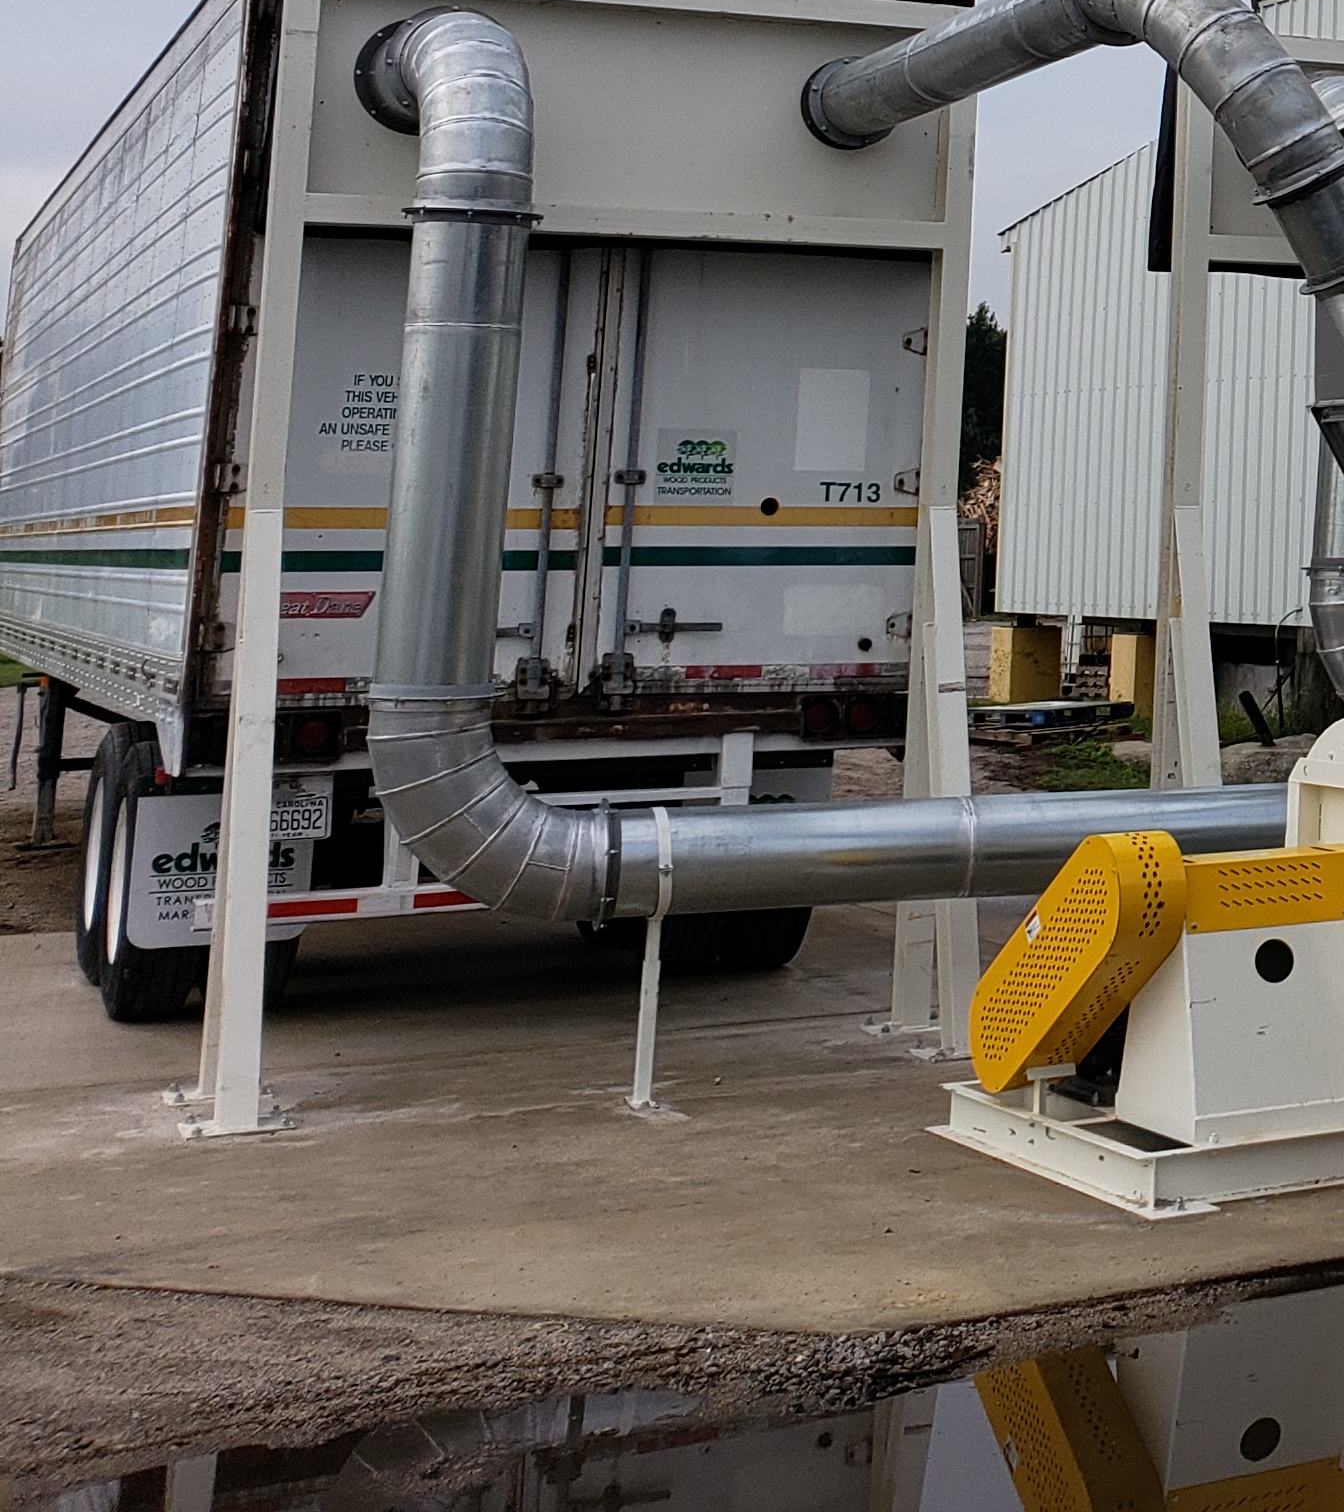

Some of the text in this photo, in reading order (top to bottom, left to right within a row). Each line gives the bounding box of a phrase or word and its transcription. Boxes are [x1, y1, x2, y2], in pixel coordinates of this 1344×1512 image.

[354, 374, 366, 386] IF
[369, 374, 394, 387] YOU
[345, 390, 373, 403] THIS
[341, 406, 397, 419] OPERATI
[319, 422, 391, 436] AN UNSAFE
[341, 439, 389, 452] PLEASE
[657, 456, 734, 474] edwards
[663, 476, 727, 484] WOOD PRODUCTS
[657, 487, 732, 496] TRANSPORTATION
[820, 481, 881, 503] T713
[310, 595, 362, 615] Dane
[276, 799, 324, 808] CAROLINA
[270, 808, 323, 832] 66692
[152, 841, 295, 874] edwds
[158, 876, 208, 889] WOOD
